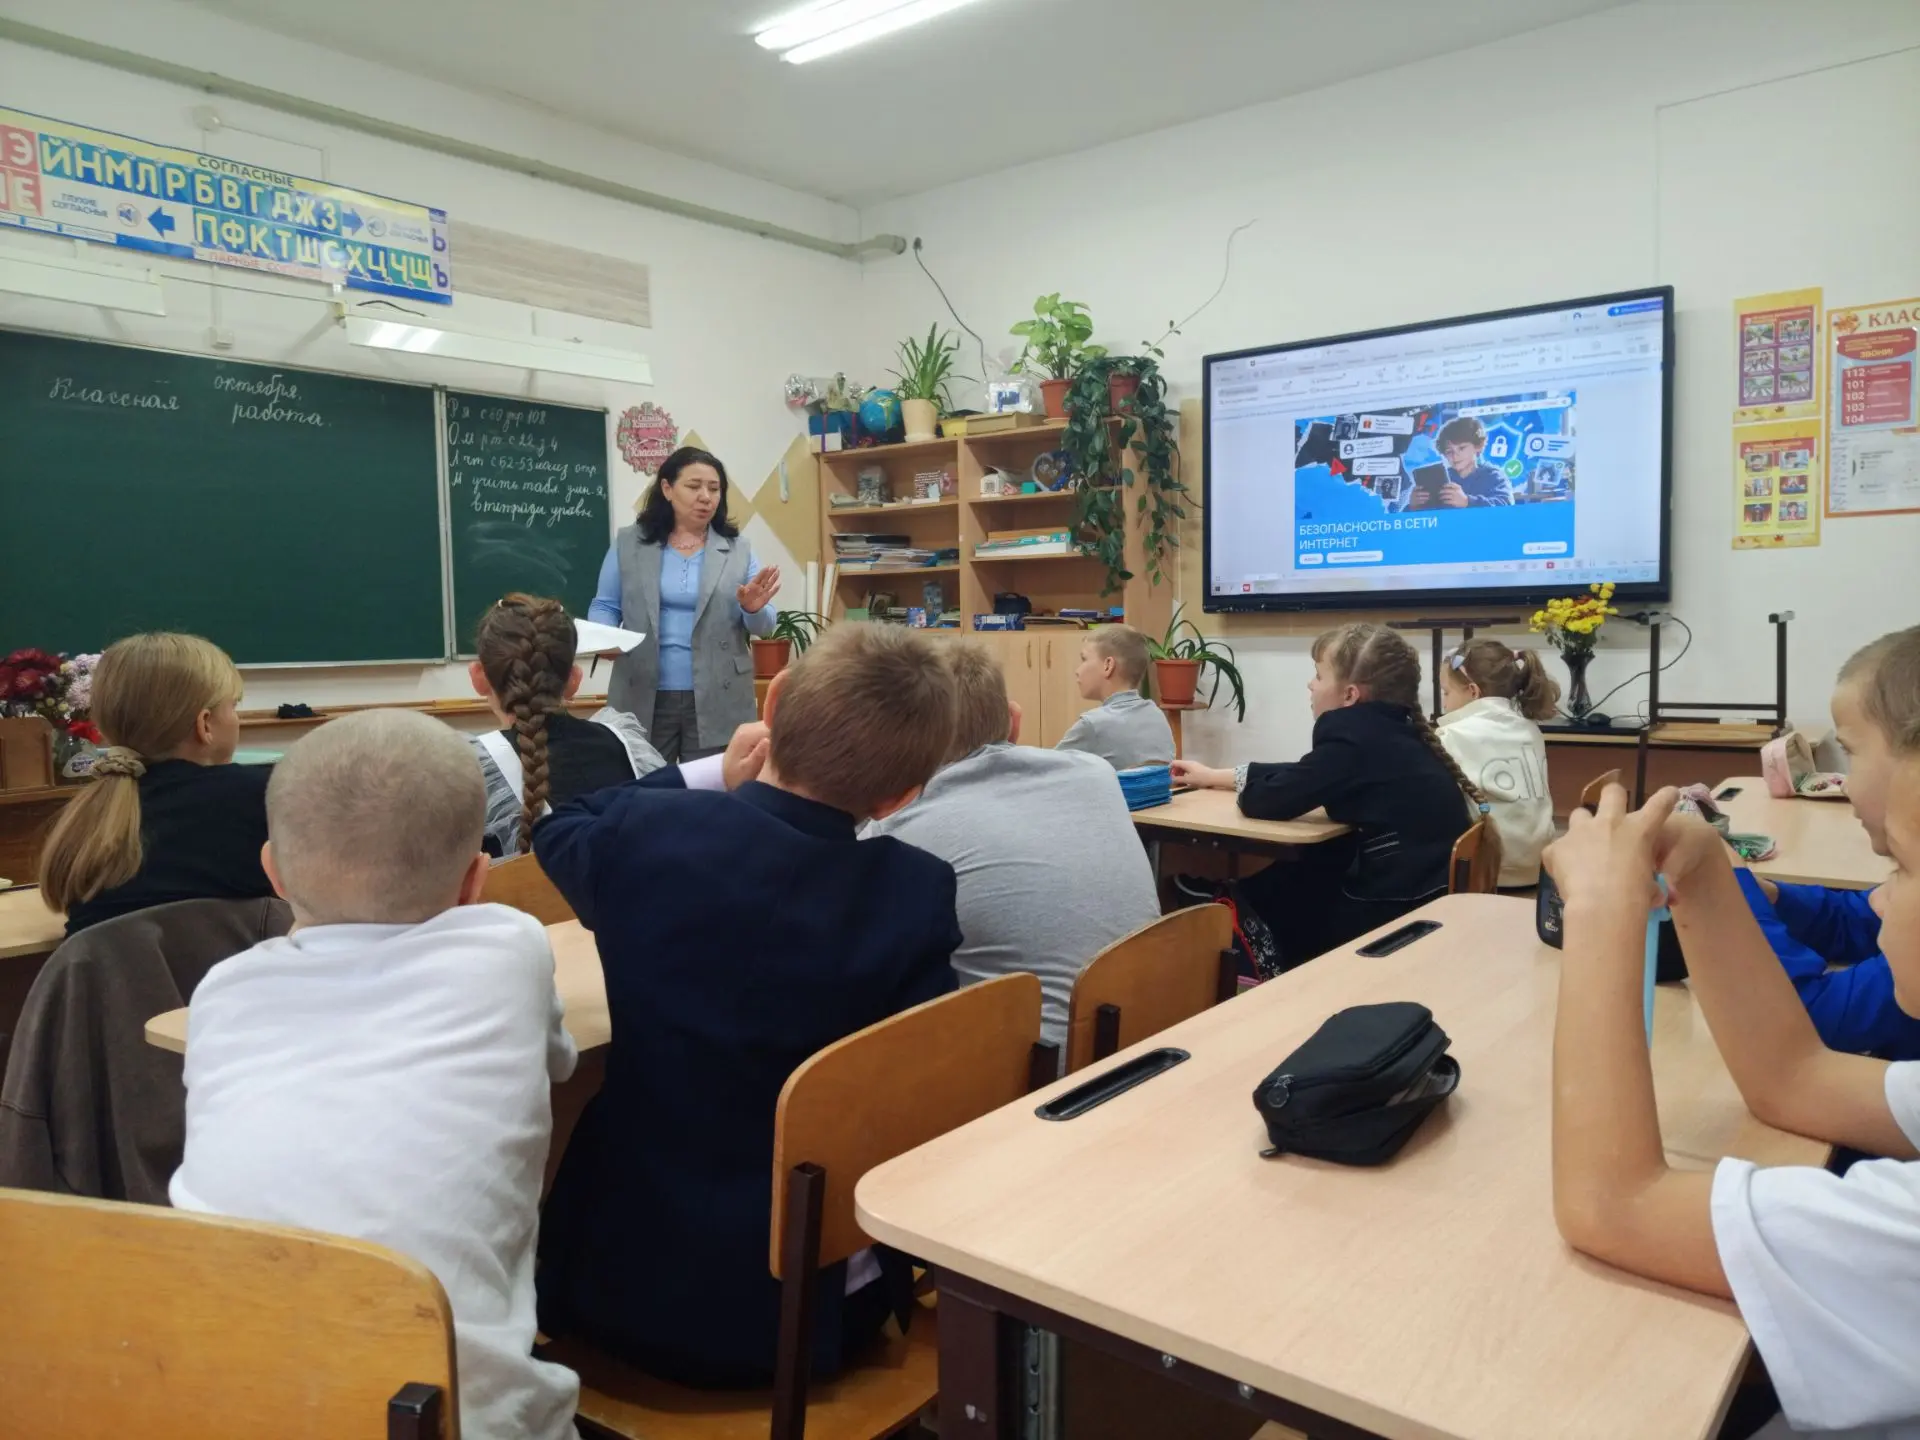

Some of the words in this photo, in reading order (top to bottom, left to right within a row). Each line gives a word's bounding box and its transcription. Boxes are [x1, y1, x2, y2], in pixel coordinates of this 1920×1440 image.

[197, 156, 294, 187] СОГЛАСНЫЕ
[1846, 368, 1865, 378] 112
[1846, 381, 1864, 390] 101
[49, 377, 181, 410] Классная
[1846, 392, 1865, 400] 102
[1846, 403, 1865, 412] 103
[1845, 414, 1865, 424] 104
[1300, 519, 1391, 536] БЕЗОПАСНОСТЬ
[1394, 518, 1402, 530] В
[1405, 517, 1438, 530] СЕТИ
[1299, 536, 1359, 550] ИНТЕРНЕТ
